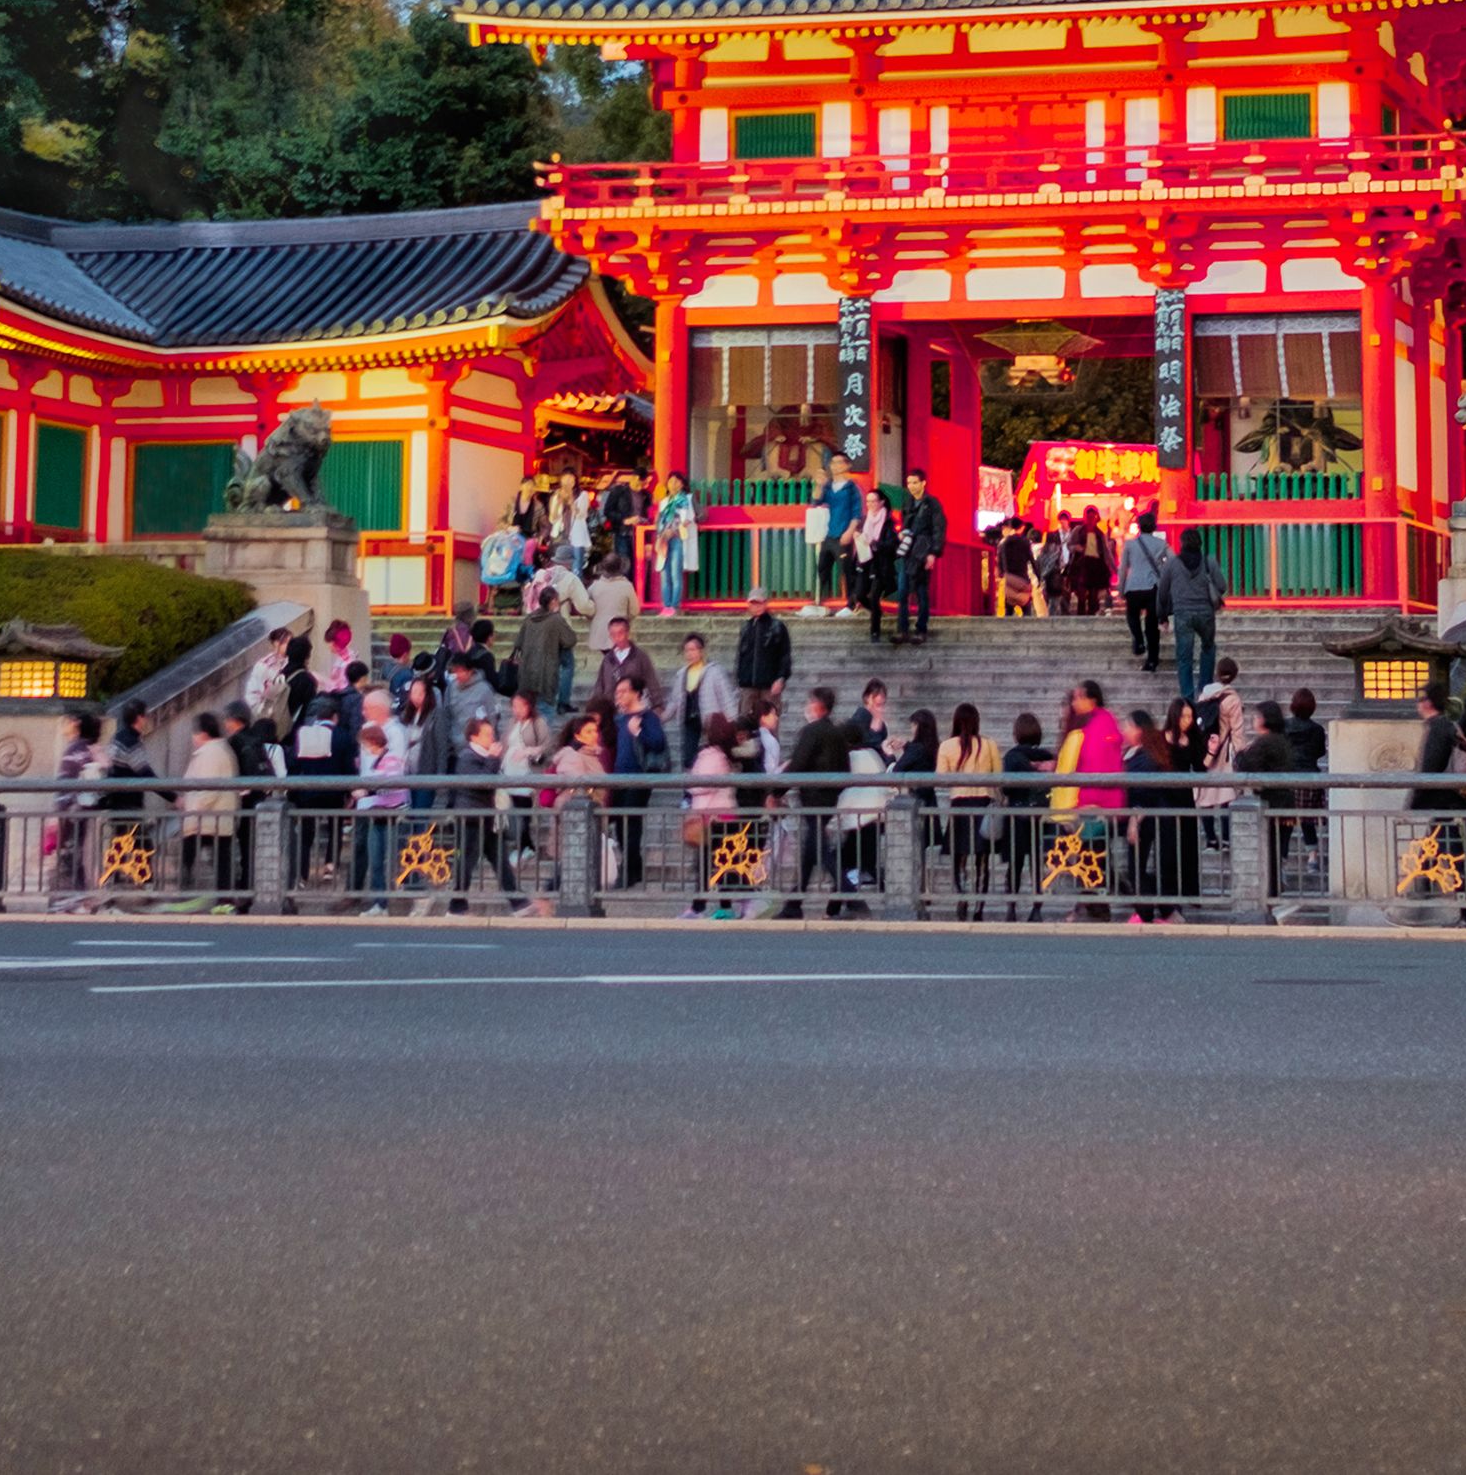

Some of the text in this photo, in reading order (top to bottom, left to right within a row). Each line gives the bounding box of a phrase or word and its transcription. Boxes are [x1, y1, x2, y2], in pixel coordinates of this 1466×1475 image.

[854, 299, 871, 362] 十一月一日
[844, 372, 867, 460] 月次祭
[1158, 360, 1183, 453] 明治祭
